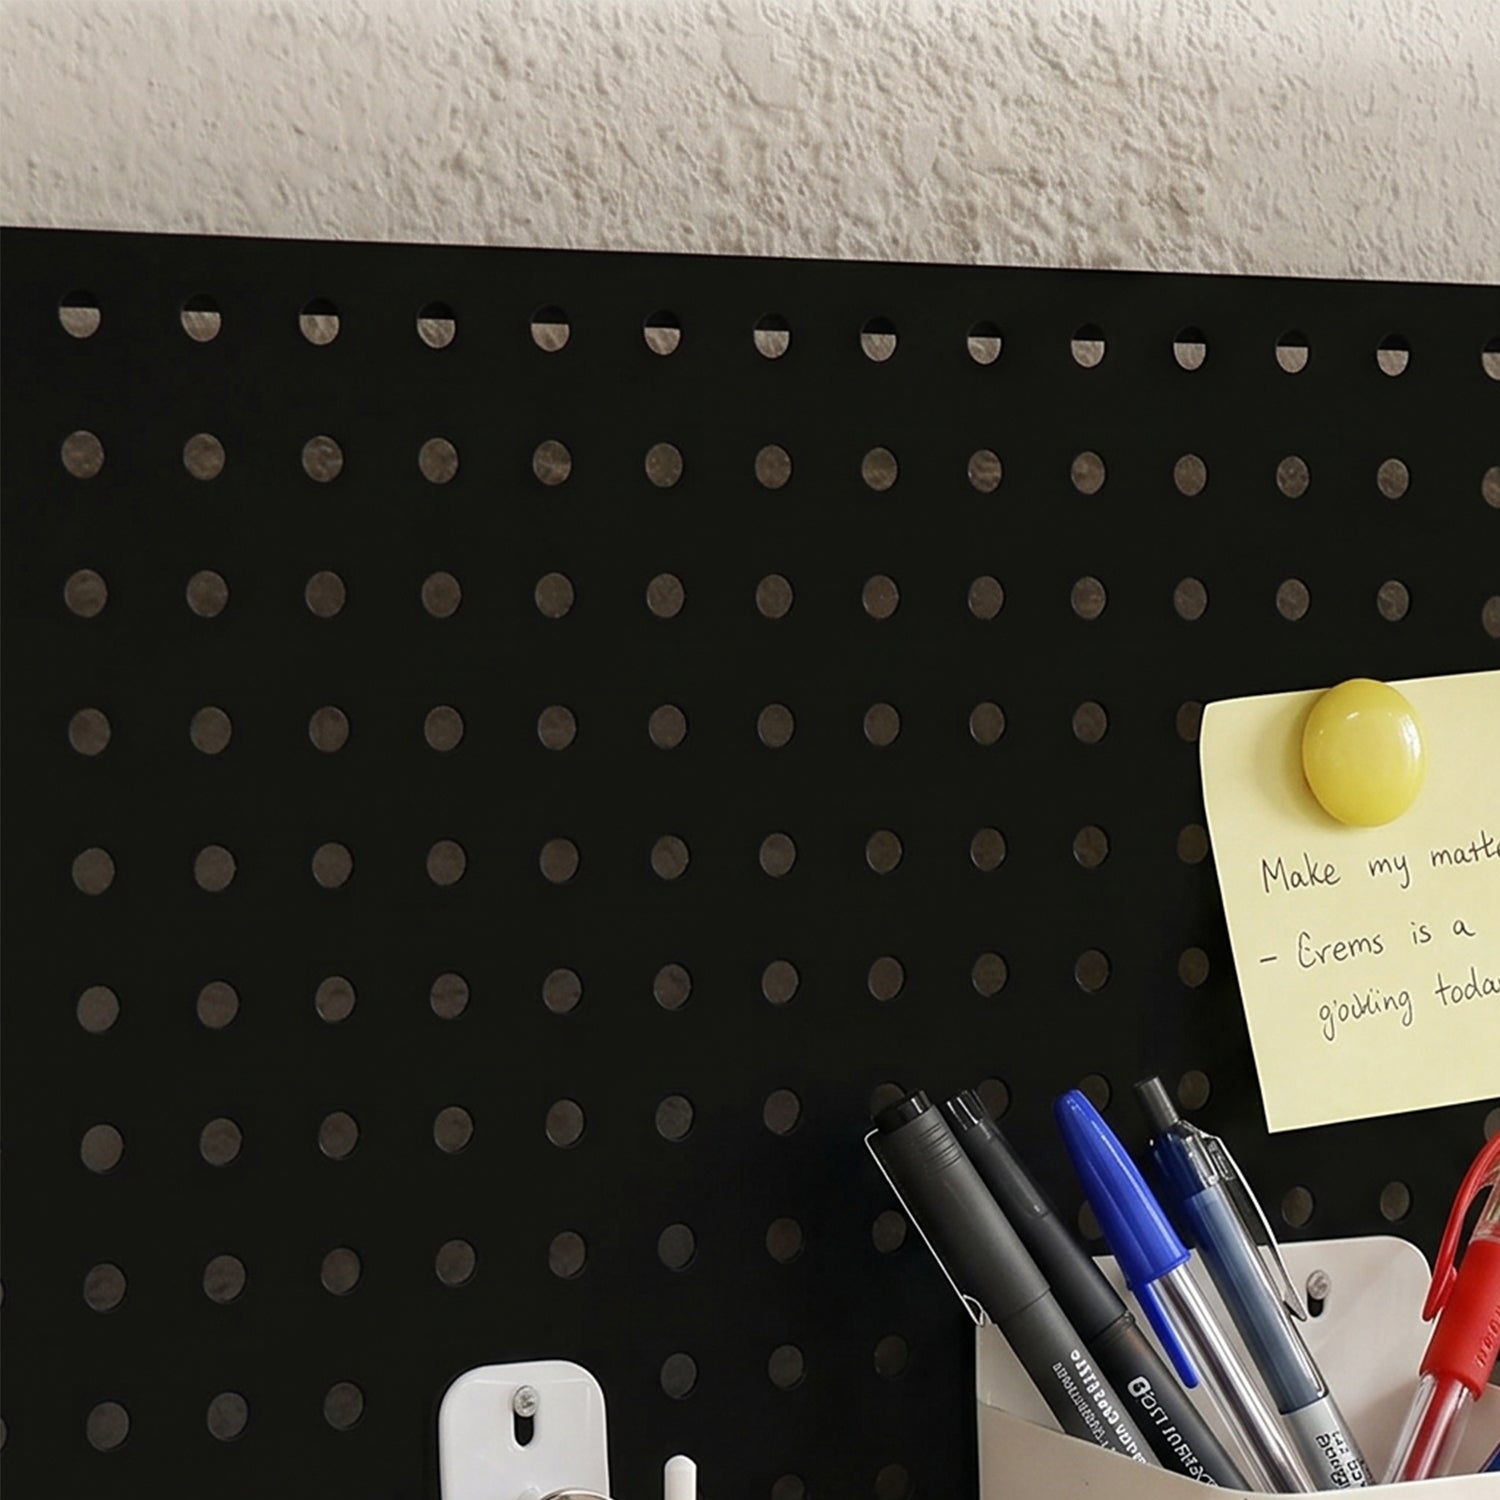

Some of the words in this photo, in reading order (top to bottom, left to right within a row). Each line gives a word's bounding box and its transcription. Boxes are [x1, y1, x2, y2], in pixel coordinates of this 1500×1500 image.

[1260, 850, 1343, 895] Make
[1367, 854, 1412, 891] my
[1409, 920, 1433, 946] is
[1451, 918, 1478, 939] a
